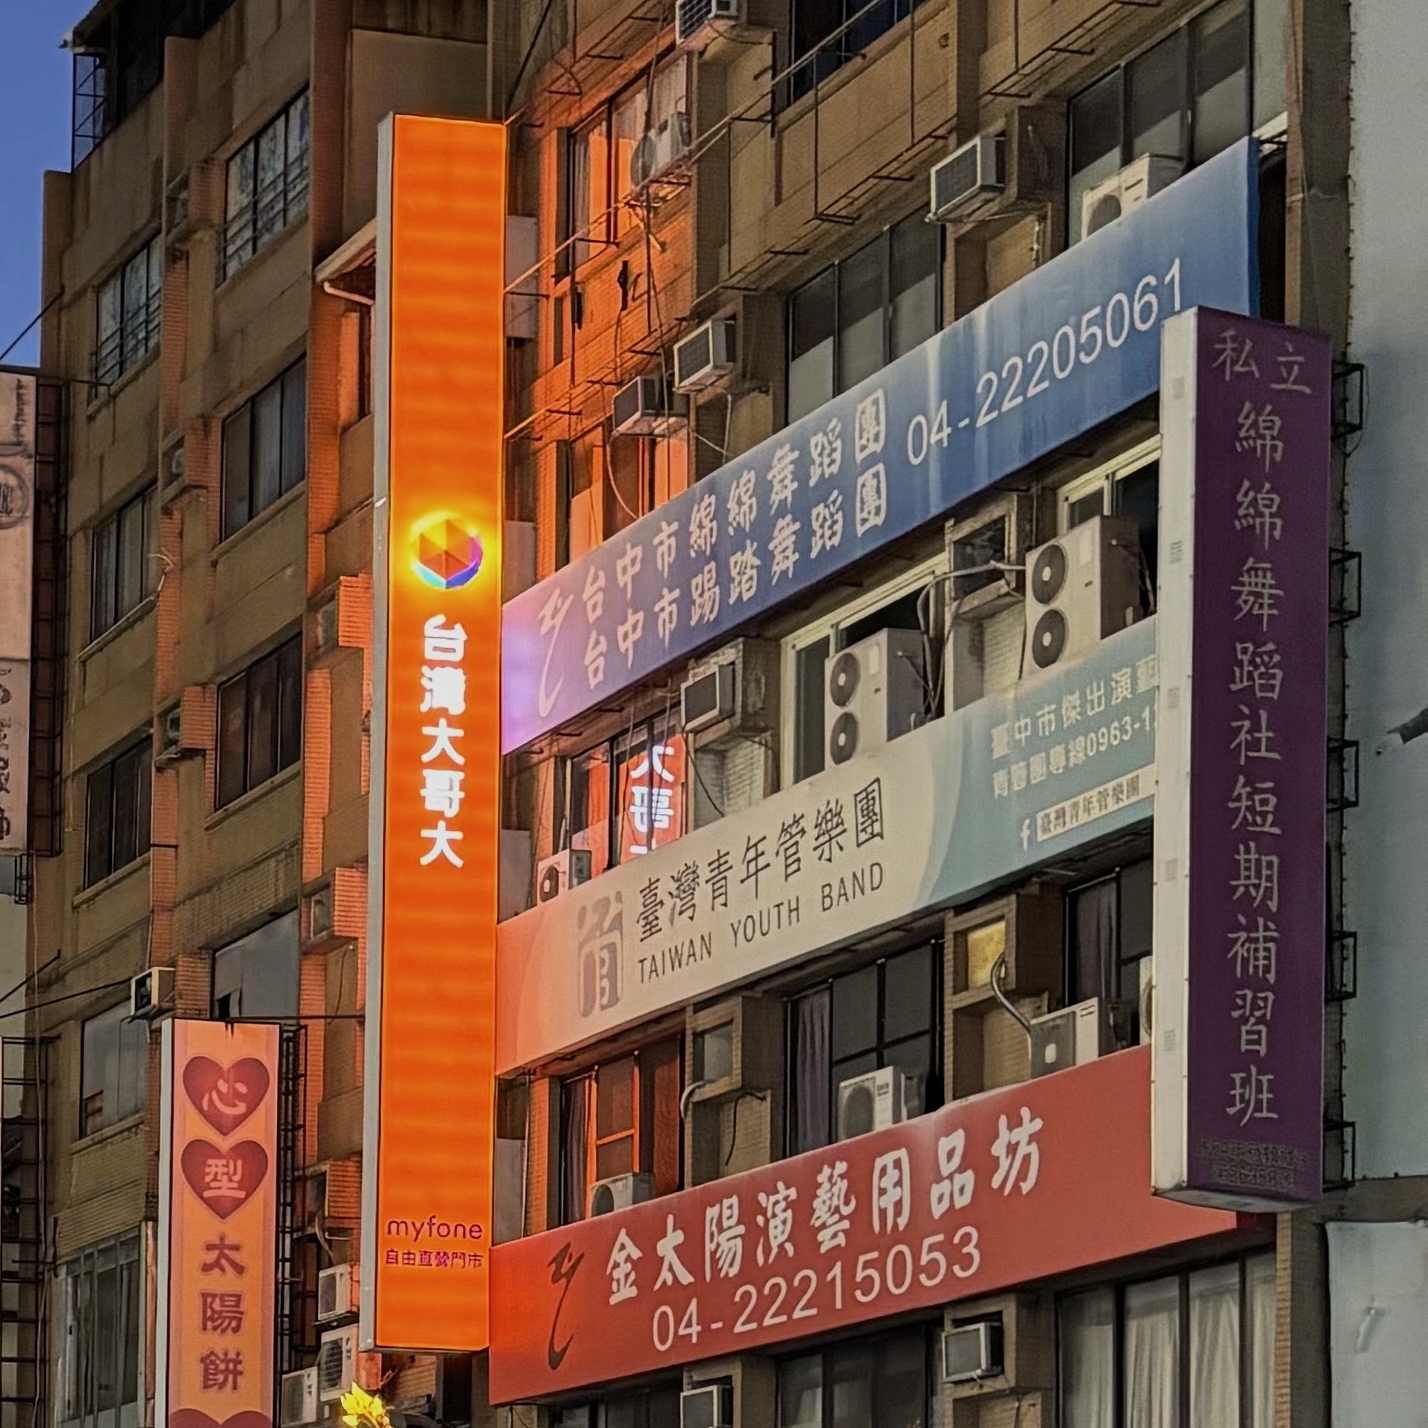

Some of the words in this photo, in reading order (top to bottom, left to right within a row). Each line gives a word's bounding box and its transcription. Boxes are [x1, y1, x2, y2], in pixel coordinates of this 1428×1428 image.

[907, 258, 1185, 467] 04-22205061
[1212, 328, 1312, 394] 私立
[583, 387, 887, 625] 台中市綿綿舞蹈團
[584, 462, 887, 691] 台中市踢踏舞蹈團
[419, 613, 468, 869] 台灣大哥大
[635, 776, 885, 944] 臺灣青年管樂團
[637, 931, 713, 985] TAIWAN
[731, 895, 801, 948] YOUTH
[821, 862, 884, 913] BAND
[385, 1248, 484, 1269] 自由直營門市
[386, 1214, 483, 1243] myfone
[605, 1104, 1045, 1305] 金太陽演藝用品坊
[651, 1225, 982, 1352] 04-22215053
